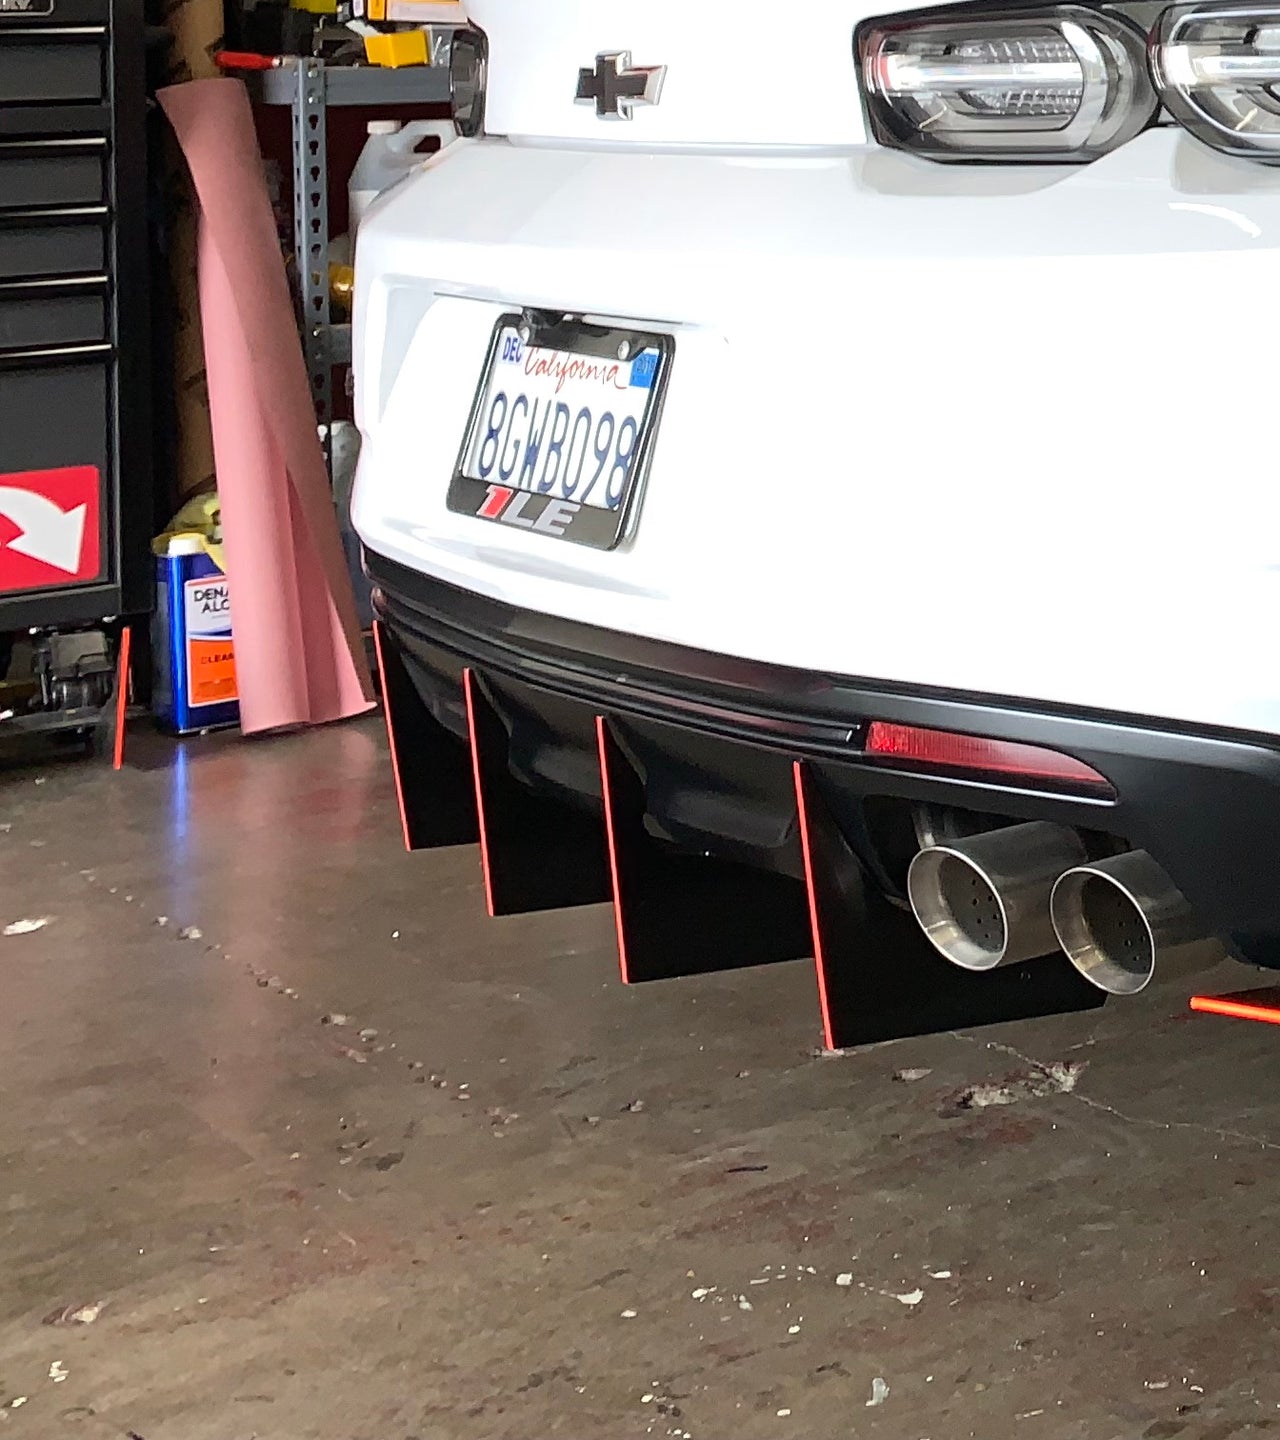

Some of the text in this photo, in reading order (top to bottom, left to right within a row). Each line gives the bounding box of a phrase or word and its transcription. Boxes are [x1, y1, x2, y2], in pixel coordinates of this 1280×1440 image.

[502, 336, 524, 363] DEC
[524, 346, 627, 394] California
[477, 390, 639, 512] 8GWB098
[475, 483, 581, 536] 1LE
[194, 585, 229, 602] DEN
